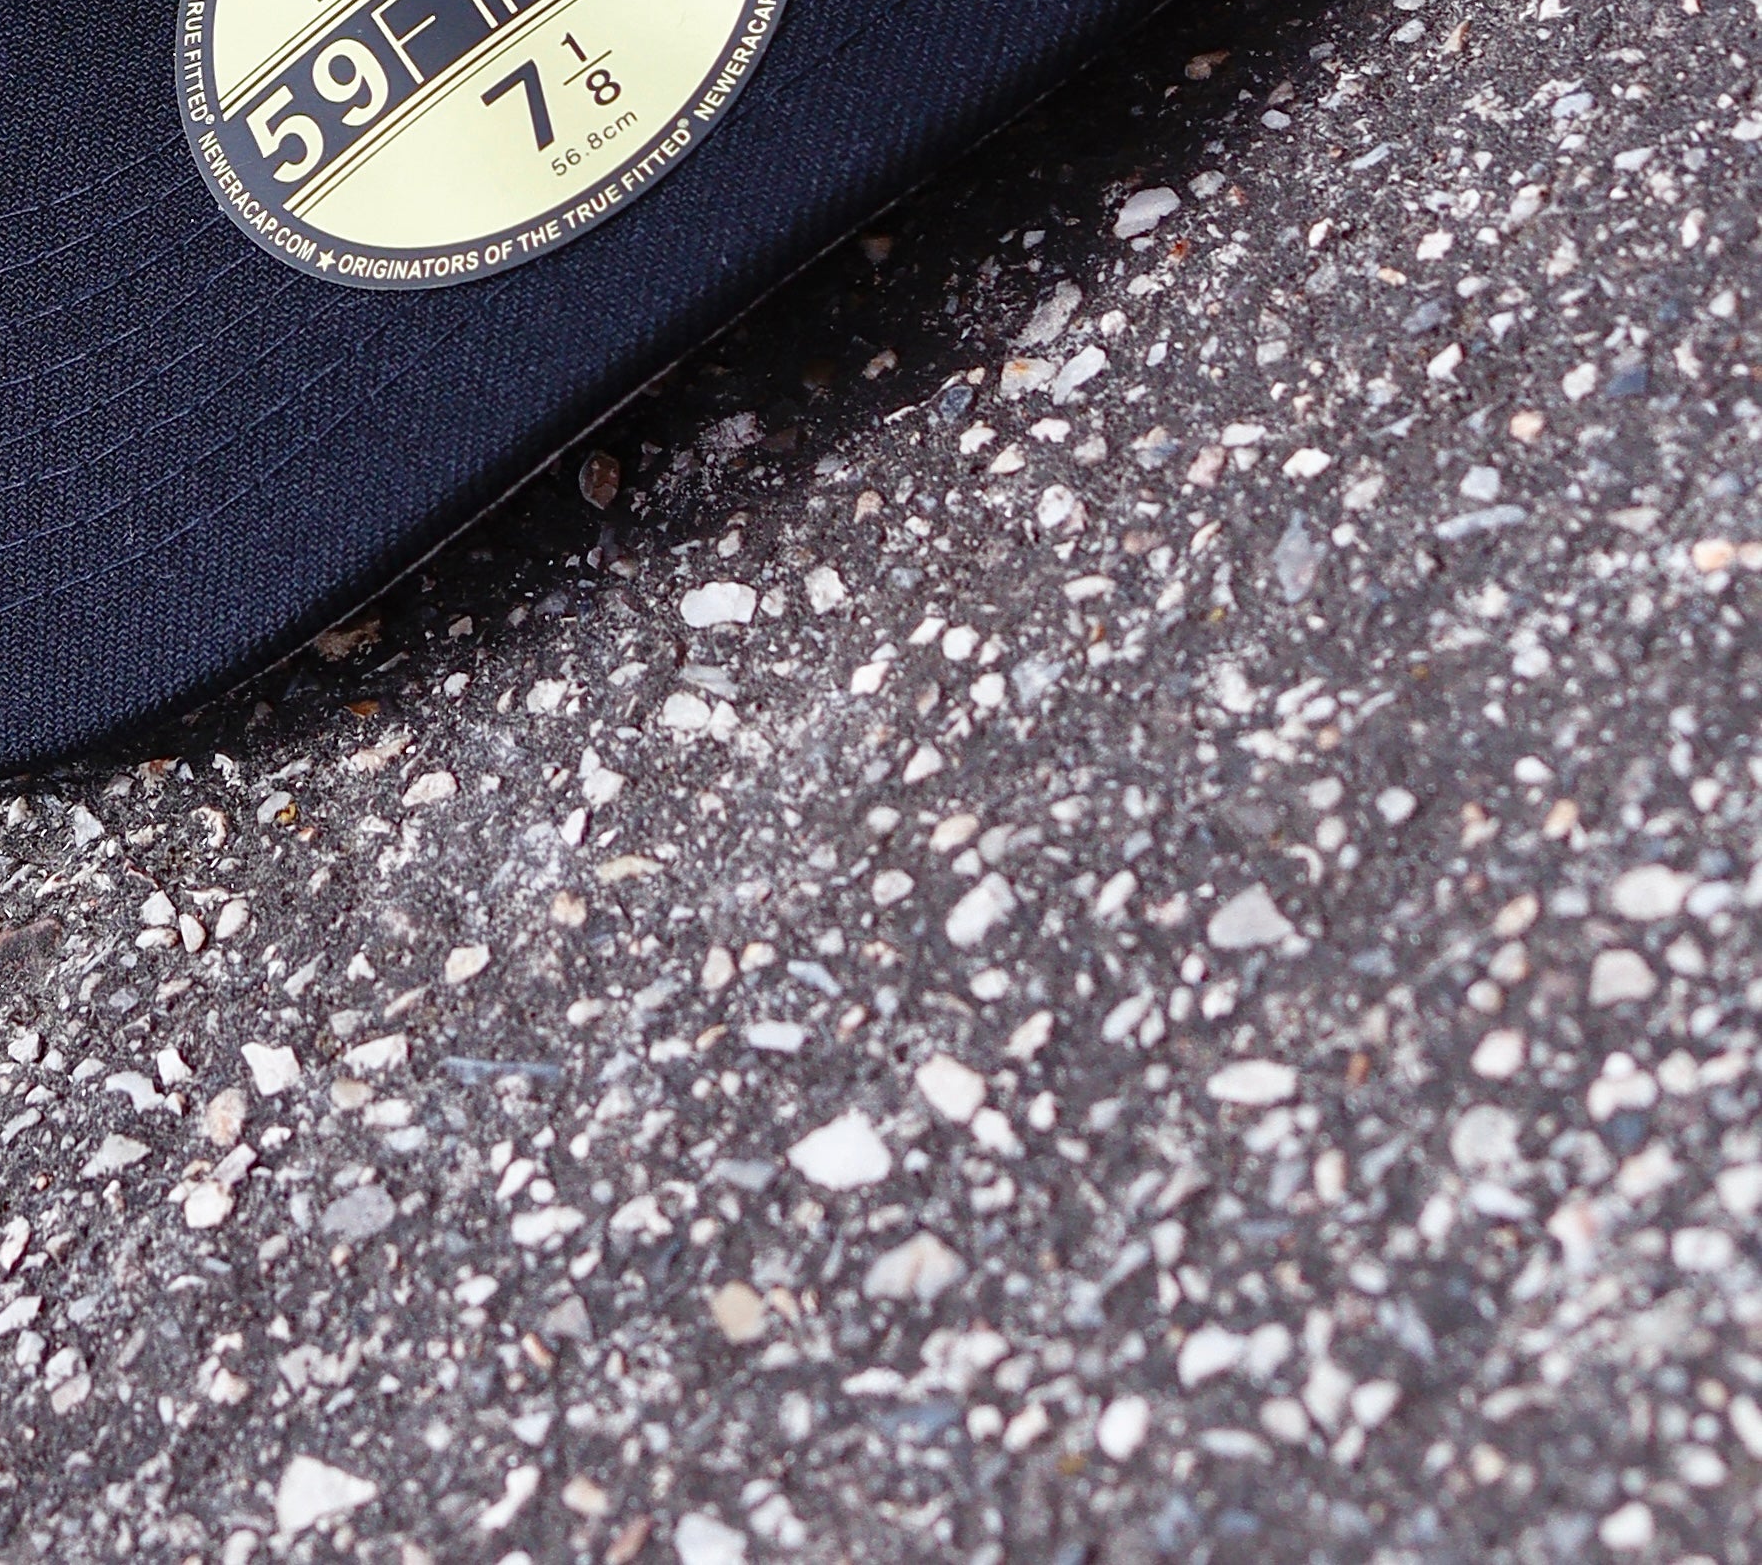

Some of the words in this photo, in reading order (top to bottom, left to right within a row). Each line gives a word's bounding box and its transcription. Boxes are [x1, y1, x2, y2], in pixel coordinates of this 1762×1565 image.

[481, 59, 554, 151] 7
[550, 110, 638, 177] 56.8cm
[198, 130, 318, 261] NEWERACAP.COM
[338, 251, 480, 279] ORIGINATORS
[484, 240, 512, 264] OF
[518, 220, 562, 251] THE
[562, 184, 623, 229] TRUE
